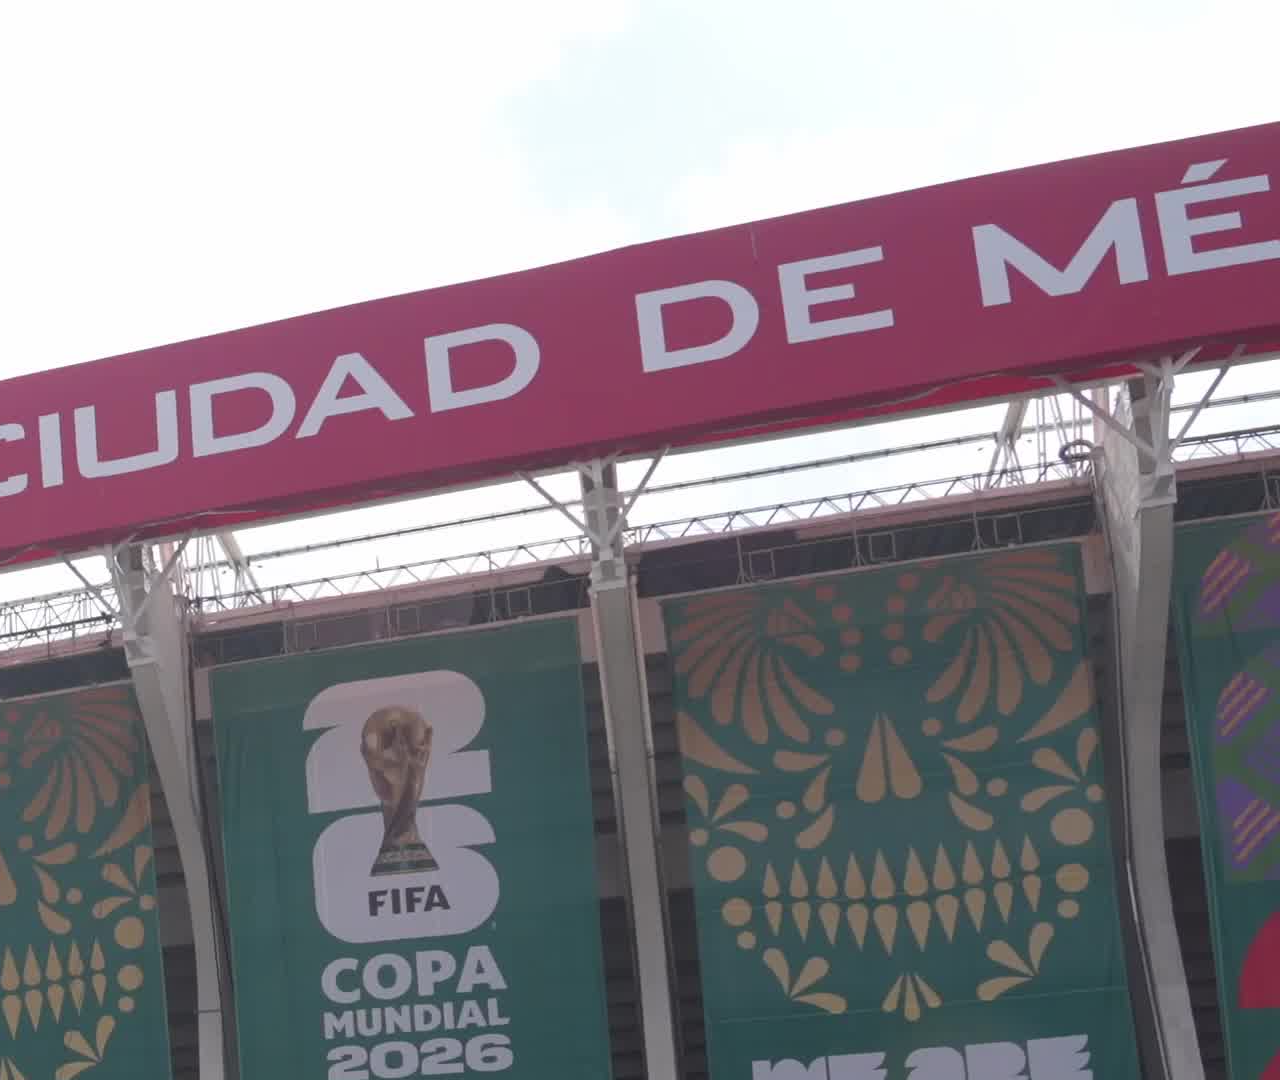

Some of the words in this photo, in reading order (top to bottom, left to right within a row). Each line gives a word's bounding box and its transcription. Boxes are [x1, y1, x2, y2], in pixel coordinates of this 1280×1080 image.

[635, 246, 894, 373] DE
[368, 885, 451, 917] FIFA
[321, 945, 508, 1004] COPA
[323, 998, 511, 1040] MUNDIAL
